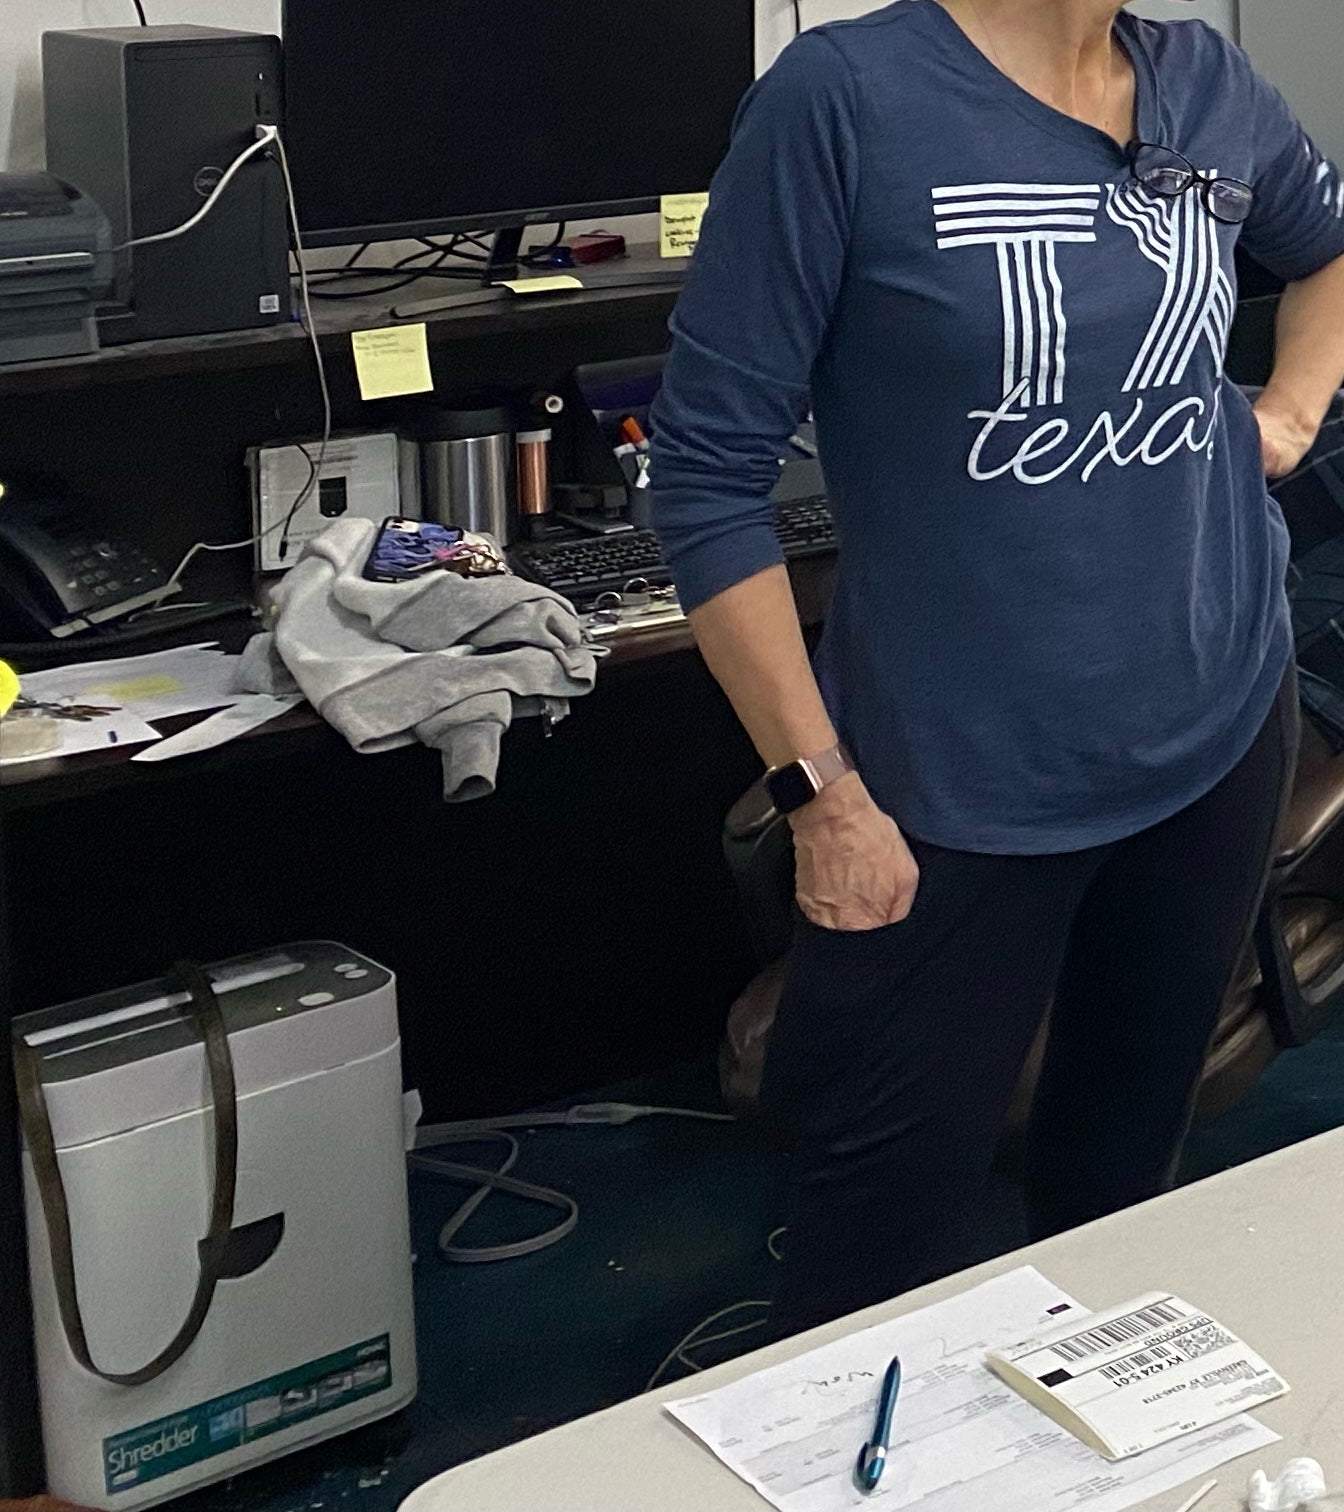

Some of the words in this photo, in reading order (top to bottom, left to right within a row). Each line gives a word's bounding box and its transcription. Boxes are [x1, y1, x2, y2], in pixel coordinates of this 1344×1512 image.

[931, 169, 1234, 408] TX
[1188, 1316, 1214, 1331] UPS
[1143, 1325, 1189, 1348] GROUND
[1140, 1361, 1165, 1378] 424
[1165, 1354, 1185, 1370] KY
[1112, 1371, 1142, 1388] 5-01
[107, 1422, 201, 1475] Shredder
